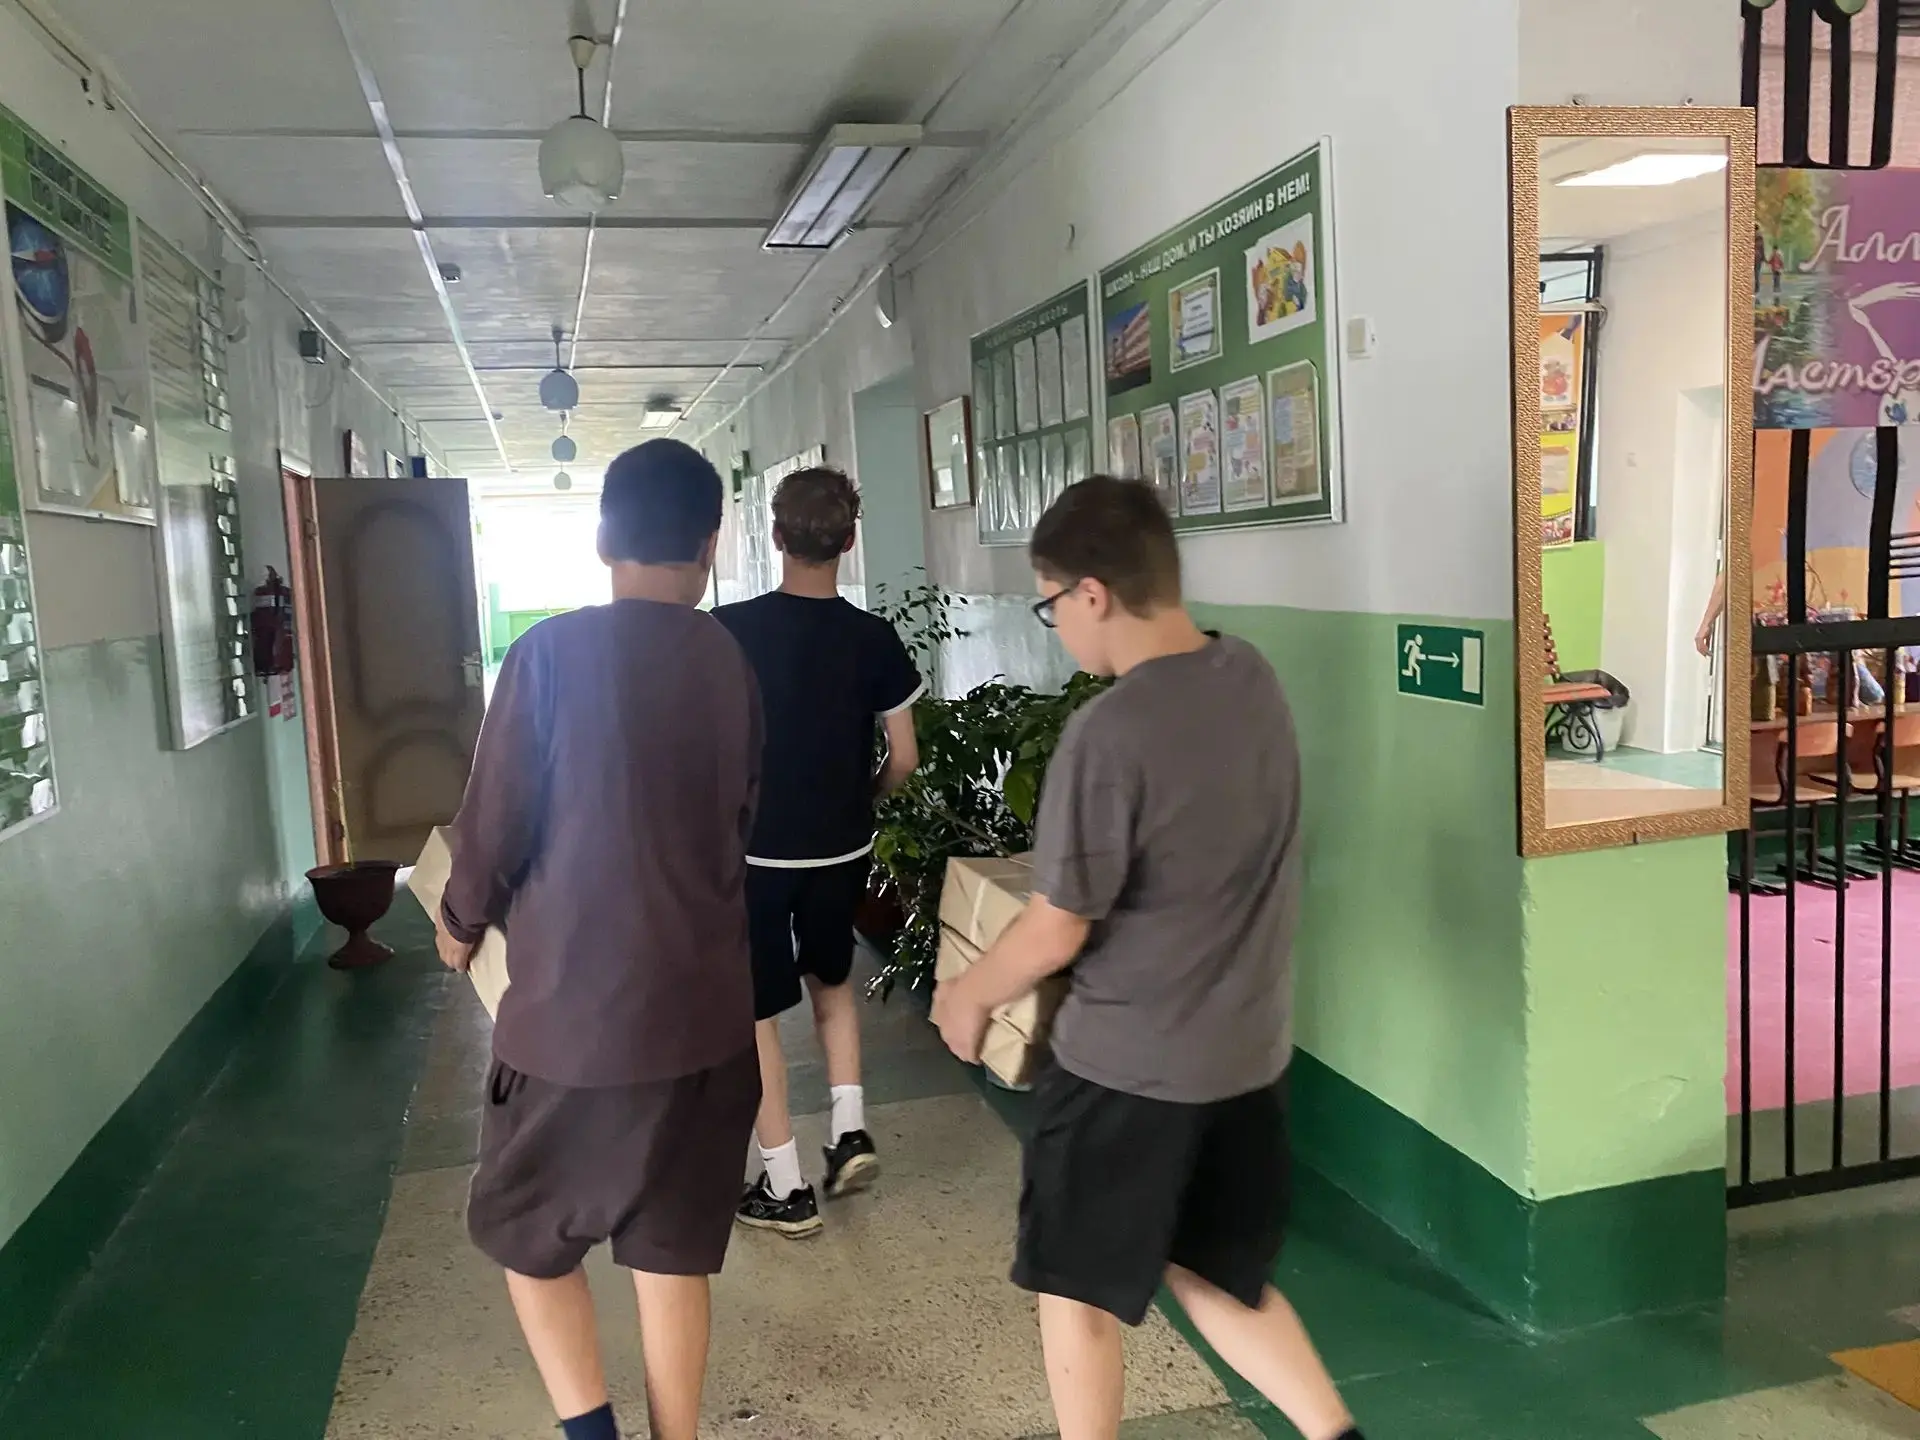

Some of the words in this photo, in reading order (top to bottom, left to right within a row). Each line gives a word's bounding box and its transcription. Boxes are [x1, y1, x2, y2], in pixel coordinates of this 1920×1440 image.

[1188, 234, 1198, 254] И
[1199, 227, 1216, 247] ТЫ
[1216, 198, 1263, 239] ХОЗЯИН
[1265, 192, 1275, 213] В
[1277, 172, 1311, 206] НЕМ!
